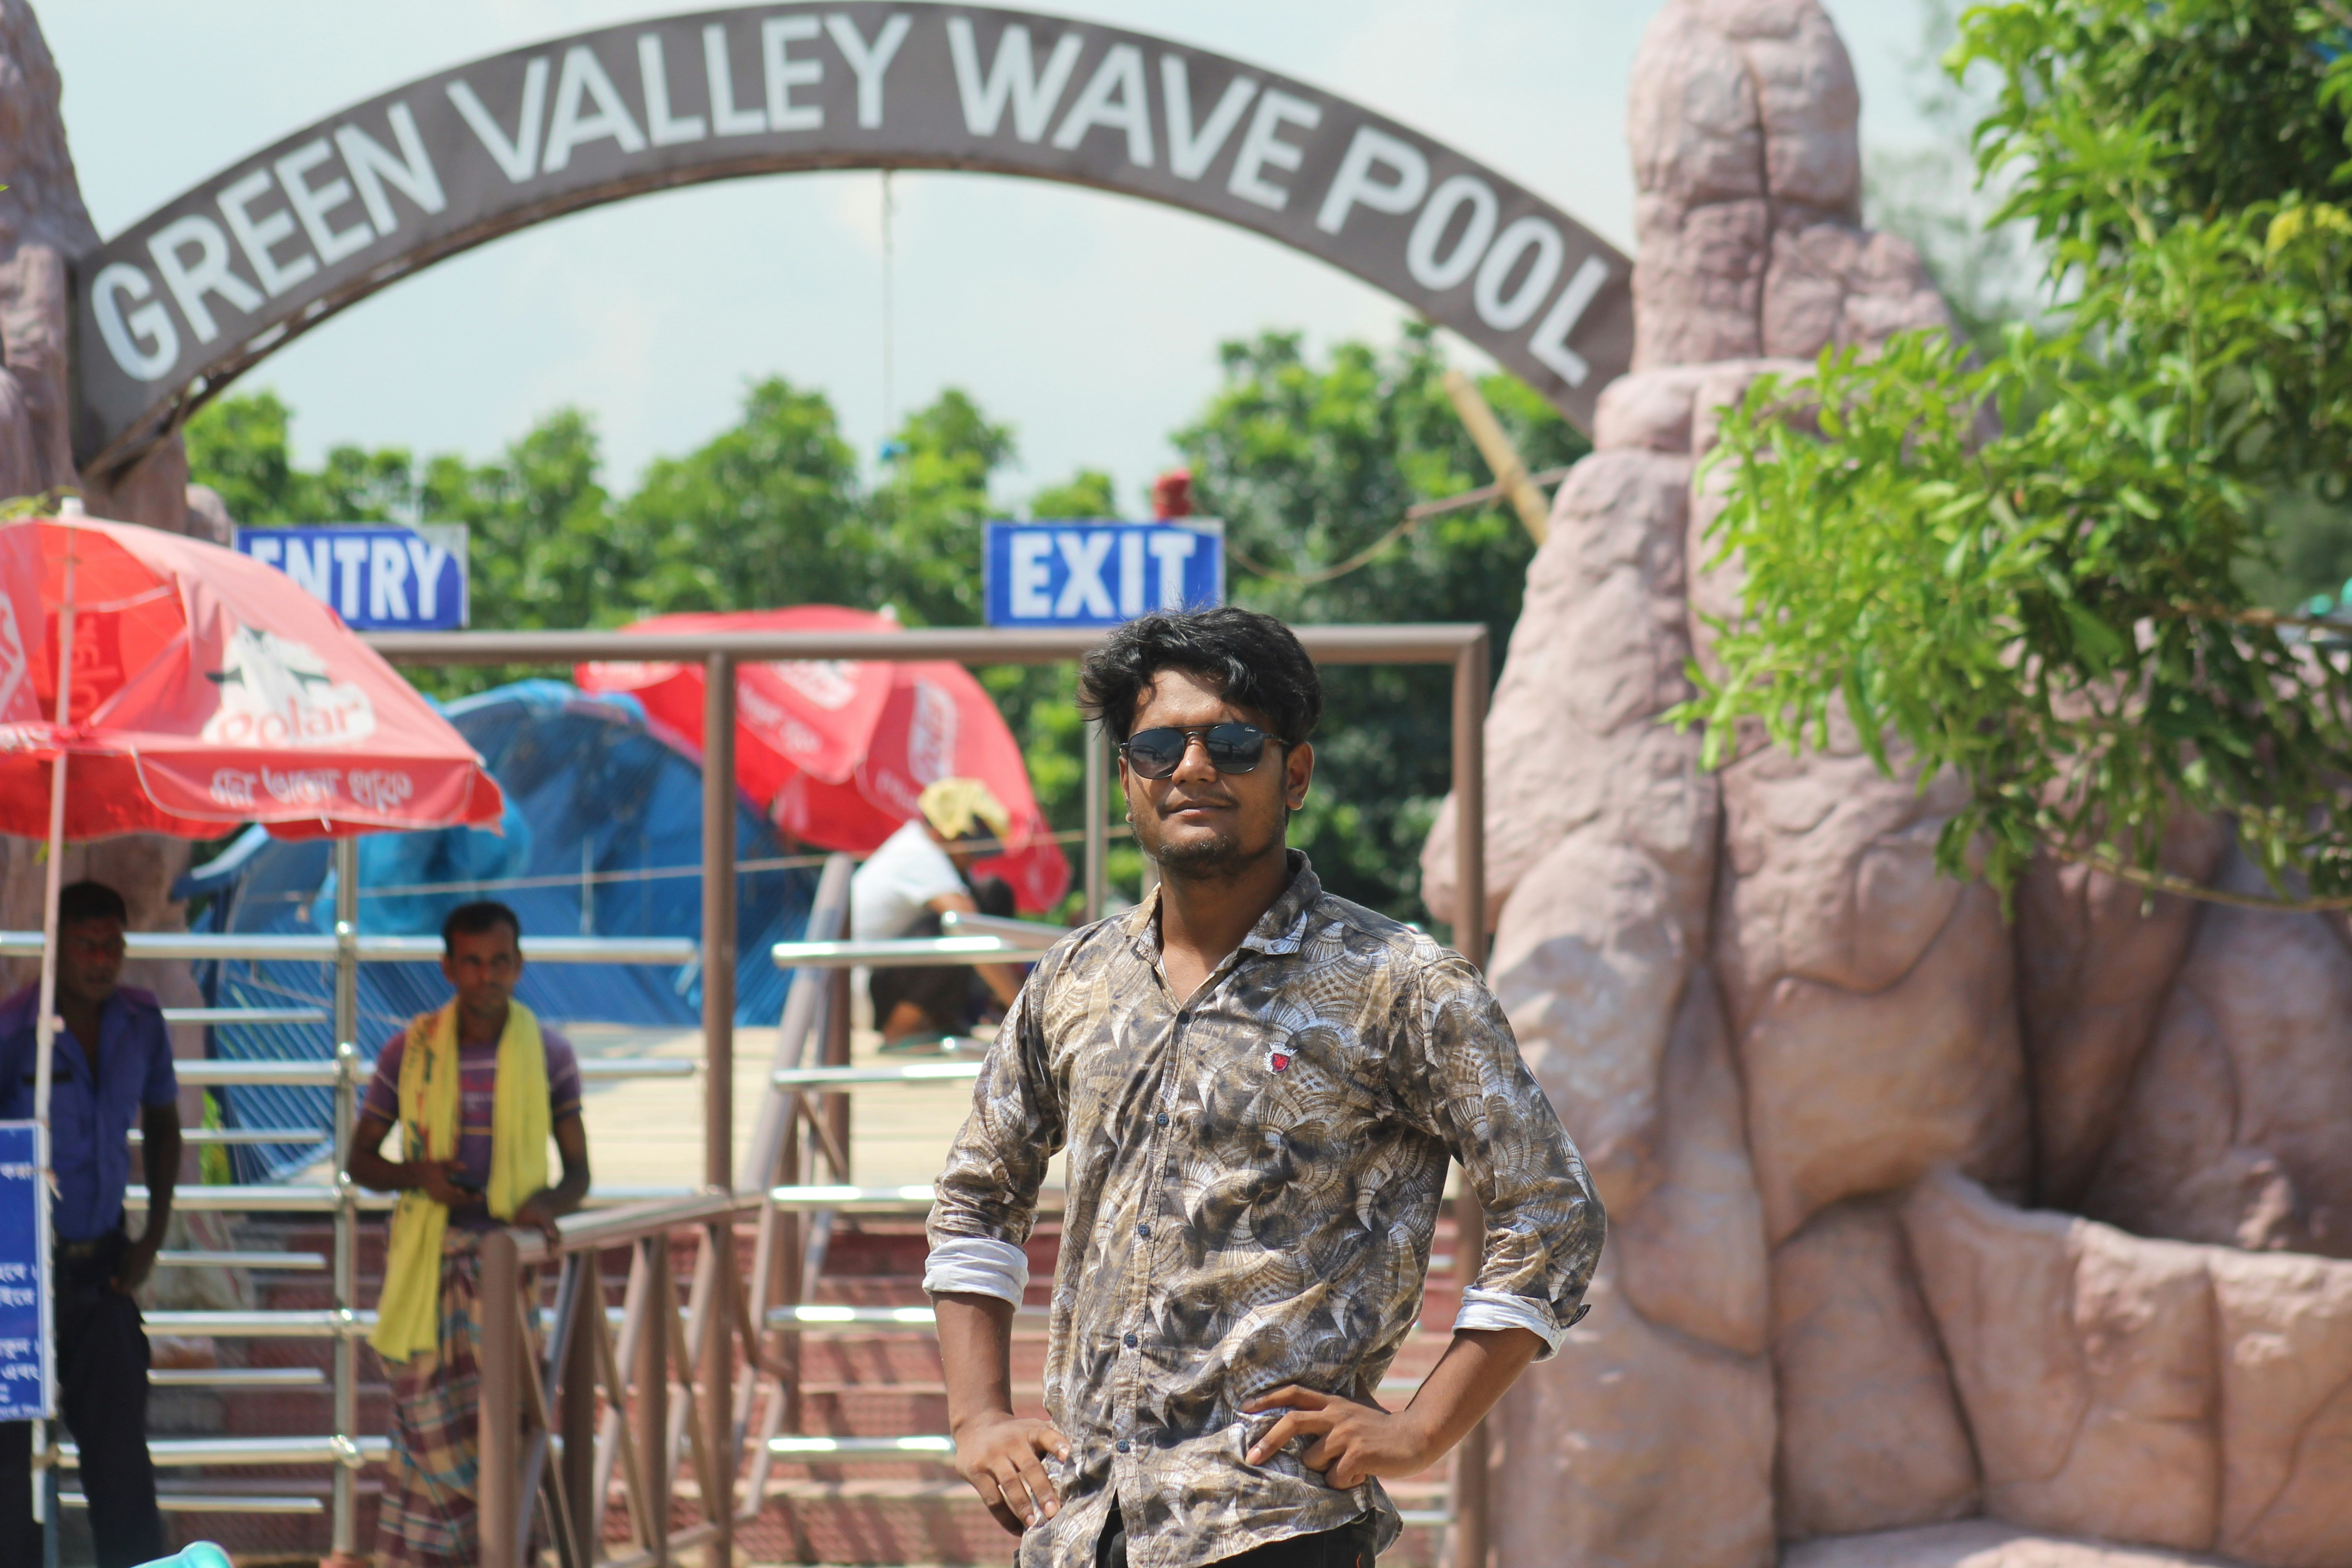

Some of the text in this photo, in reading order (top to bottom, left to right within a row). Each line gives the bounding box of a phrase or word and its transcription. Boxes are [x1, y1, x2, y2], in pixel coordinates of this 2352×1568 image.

[92, 14, 1609, 388] GREEN VALLEY WAVE POOL
[1009, 530, 1196, 618] EXIT
[218, 695, 362, 748] Polar
